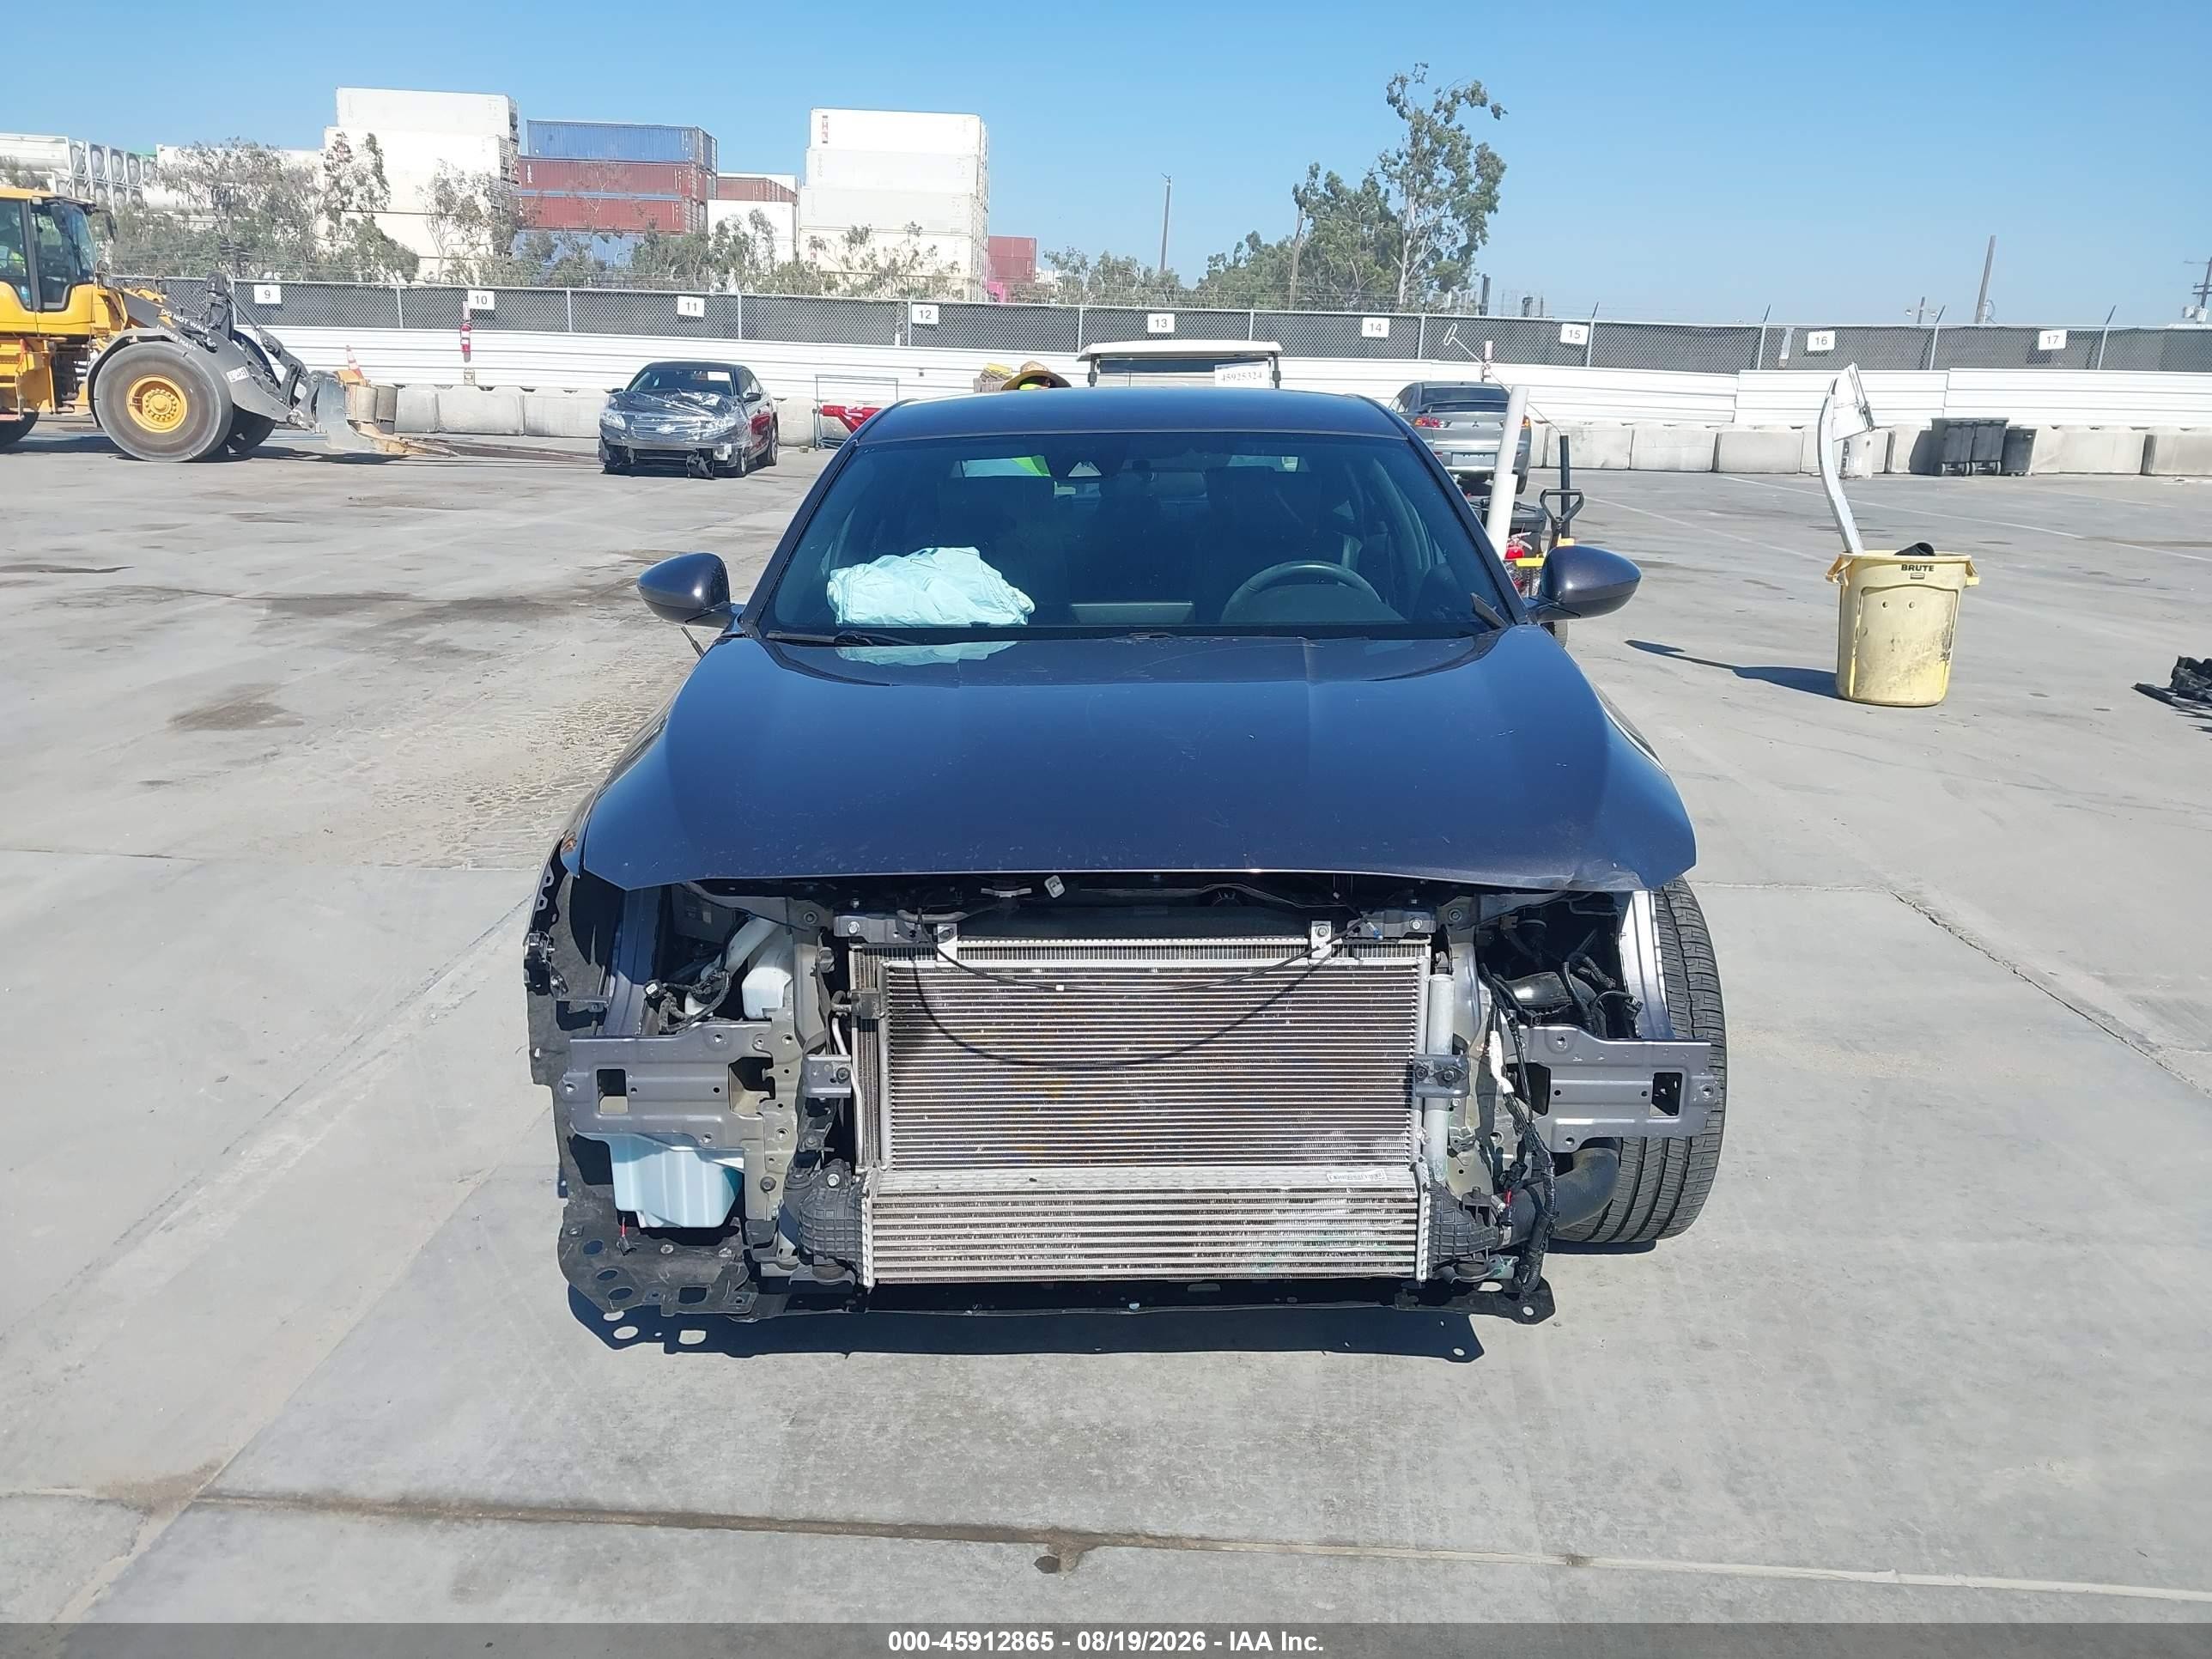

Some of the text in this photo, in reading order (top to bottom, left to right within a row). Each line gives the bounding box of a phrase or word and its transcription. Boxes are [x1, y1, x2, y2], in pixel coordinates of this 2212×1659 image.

[264, 289, 270, 300] 9
[474, 295, 488, 305] 10
[686, 301, 697, 312] 11
[920, 309, 932, 319] 12
[161, 308, 210, 334] DO NOT WALK
[1155, 318, 1167, 328] 13
[1370, 322, 1382, 332] 14
[1569, 329, 1581, 339] 15
[1814, 336, 1827, 345] 16
[2046, 335, 2058, 344] 17
[1220, 371, 1262, 383] 45925324
[1900, 563, 1935, 572] BRUTE
